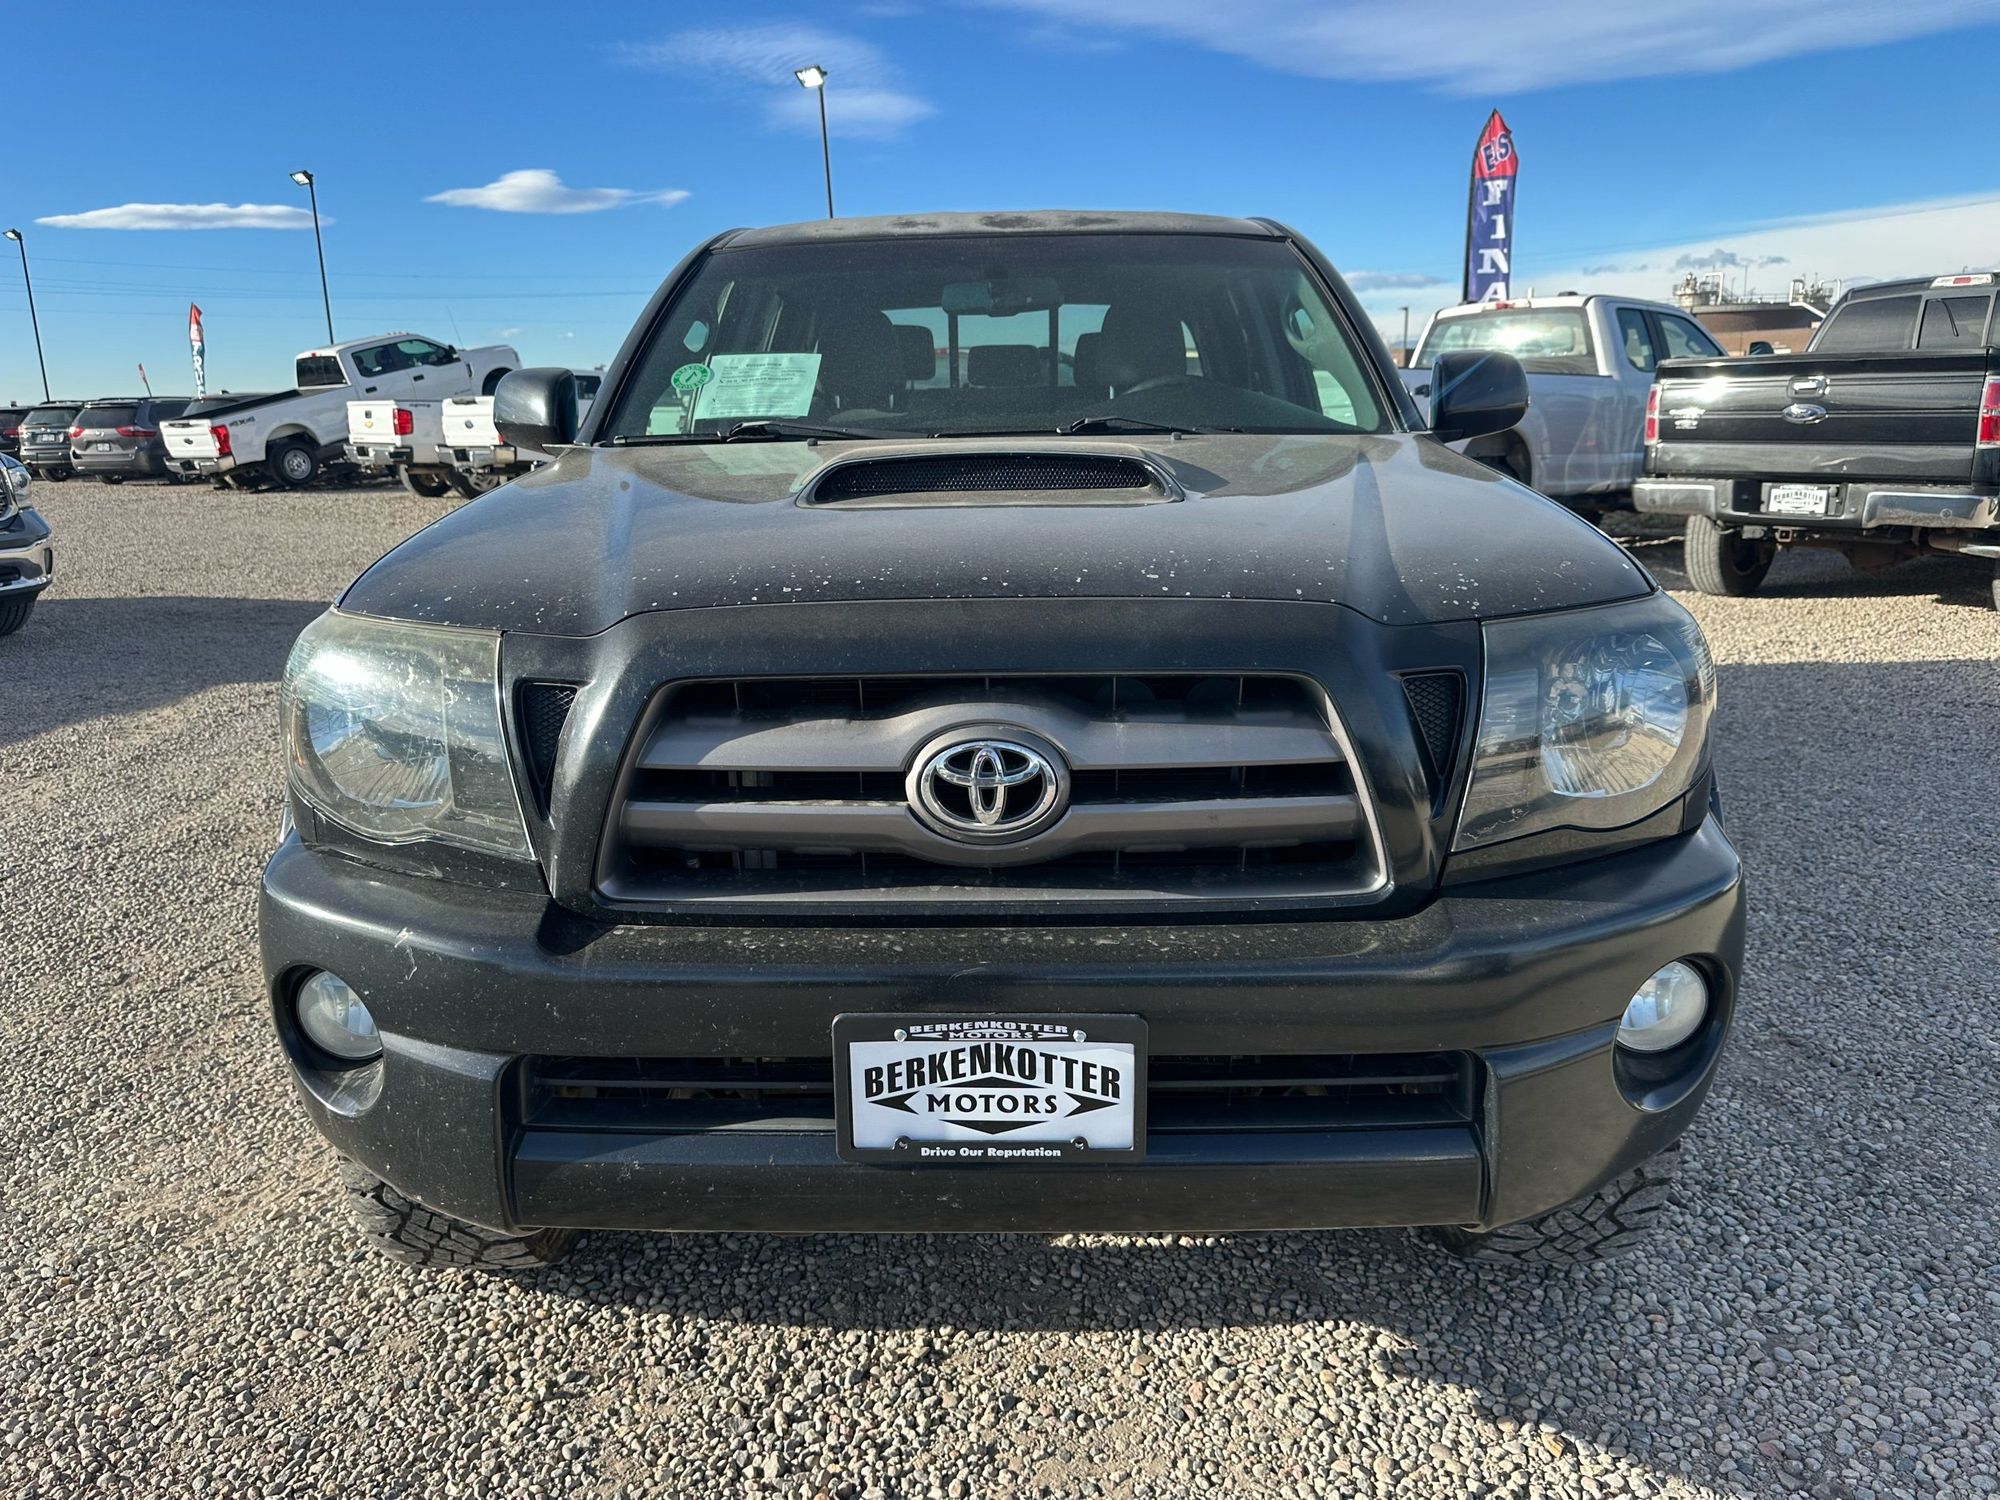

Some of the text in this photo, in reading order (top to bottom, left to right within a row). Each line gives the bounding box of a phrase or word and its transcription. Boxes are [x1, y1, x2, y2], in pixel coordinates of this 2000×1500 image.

[909, 1020, 1068, 1034] BERKENKOTTER
[949, 1031, 1033, 1039] MOTORS
[864, 1042, 1121, 1099] BERKENKOTTER
[926, 1093, 1058, 1114] MOTORS
[921, 1147, 1062, 1158] Drive Our Reputation
